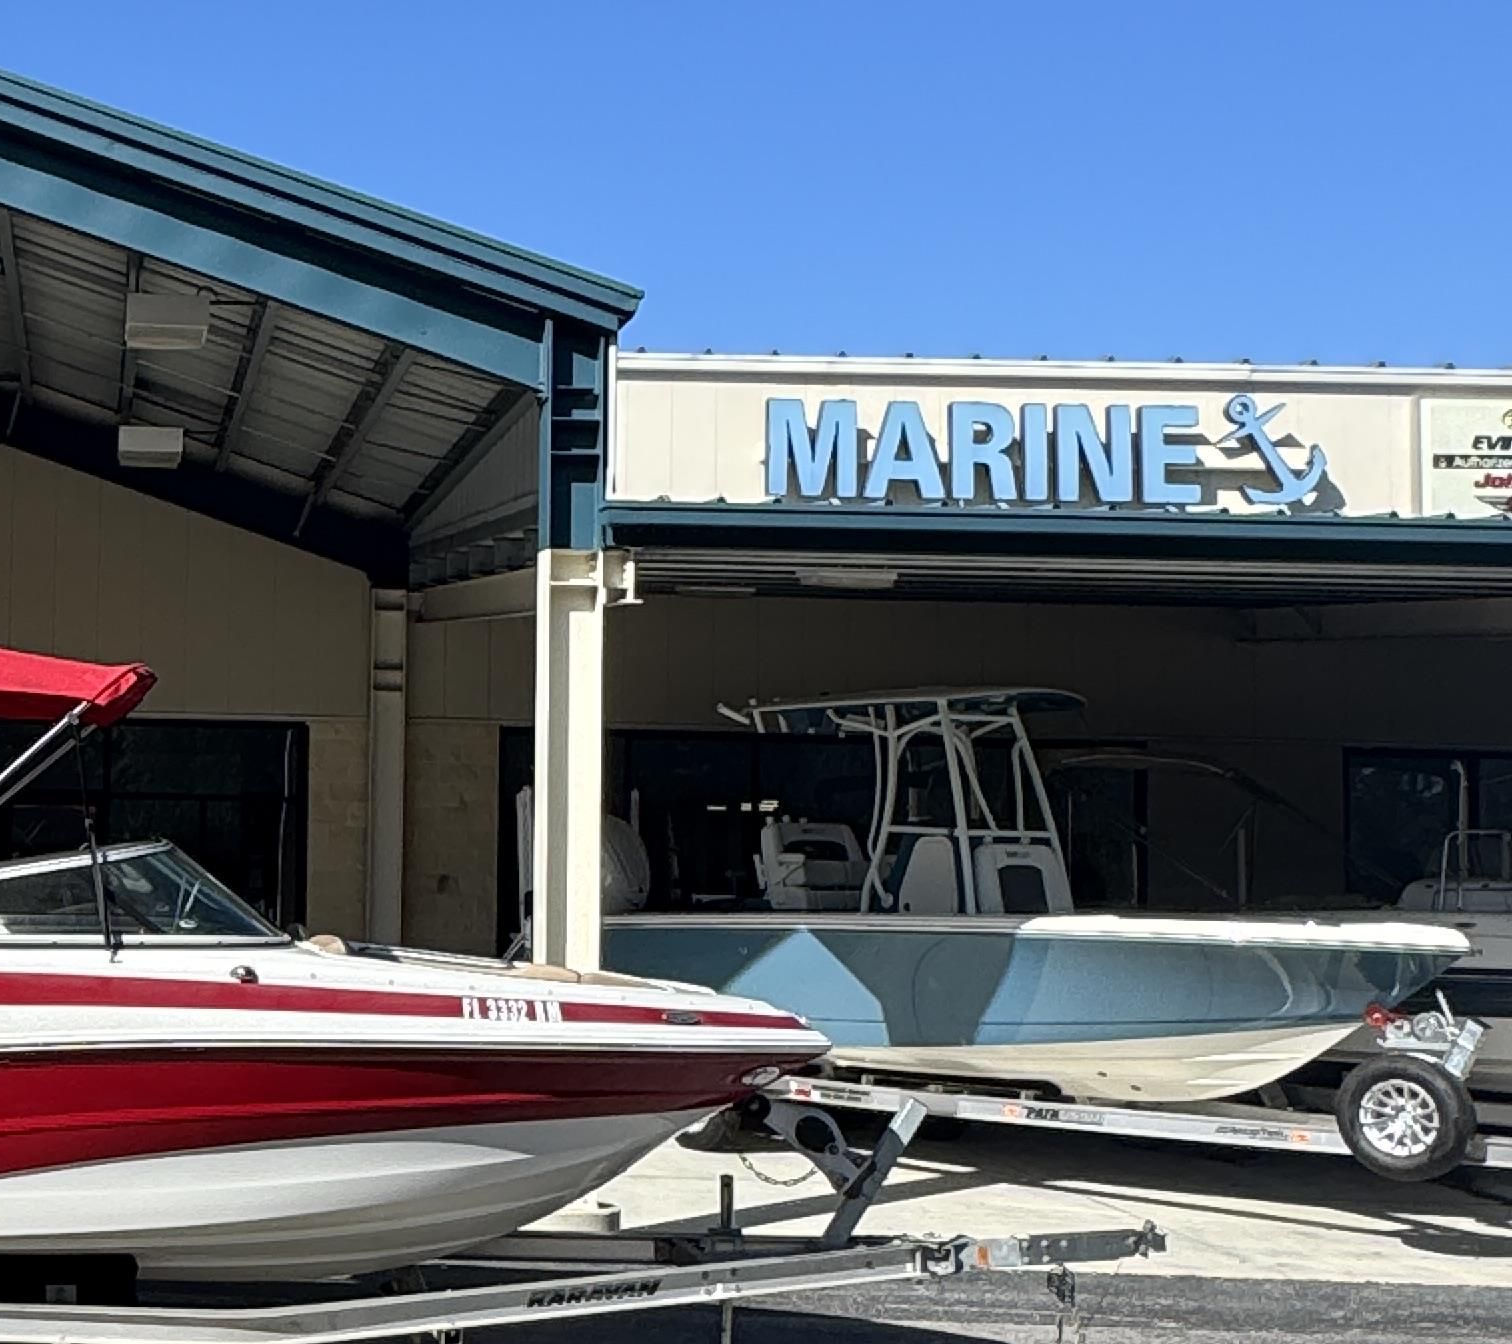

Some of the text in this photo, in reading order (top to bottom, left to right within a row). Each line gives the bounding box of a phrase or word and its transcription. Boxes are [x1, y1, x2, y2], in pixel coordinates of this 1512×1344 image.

[766, 398, 1203, 504] MARINE
[462, 996, 482, 1020] FL
[486, 998, 530, 1023] 3332
[526, 1278, 663, 1308] KARAVAN
